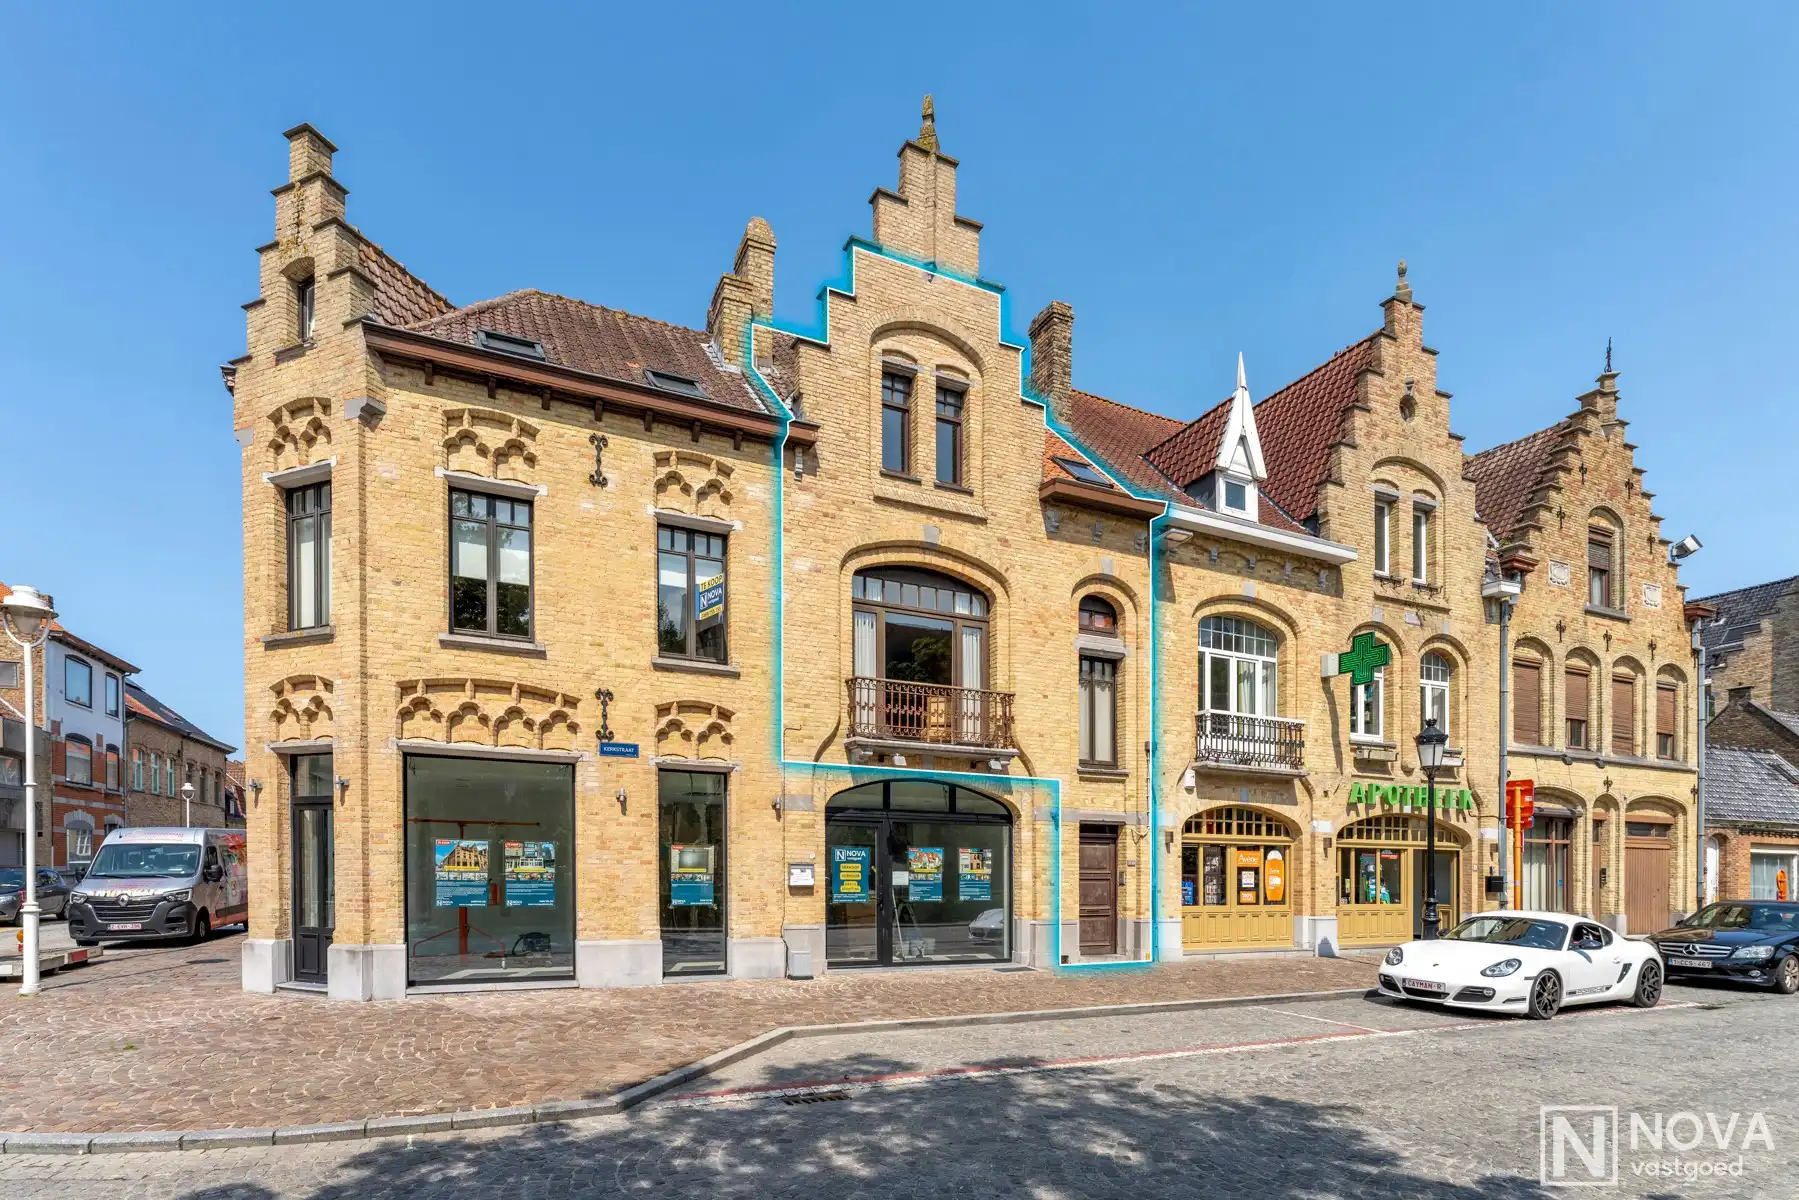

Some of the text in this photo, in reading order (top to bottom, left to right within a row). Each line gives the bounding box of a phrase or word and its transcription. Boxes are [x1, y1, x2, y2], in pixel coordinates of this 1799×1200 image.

[708, 588, 722, 599] NOVA
[1348, 781, 1473, 810] APOTHEEK
[836, 850, 845, 860] N
